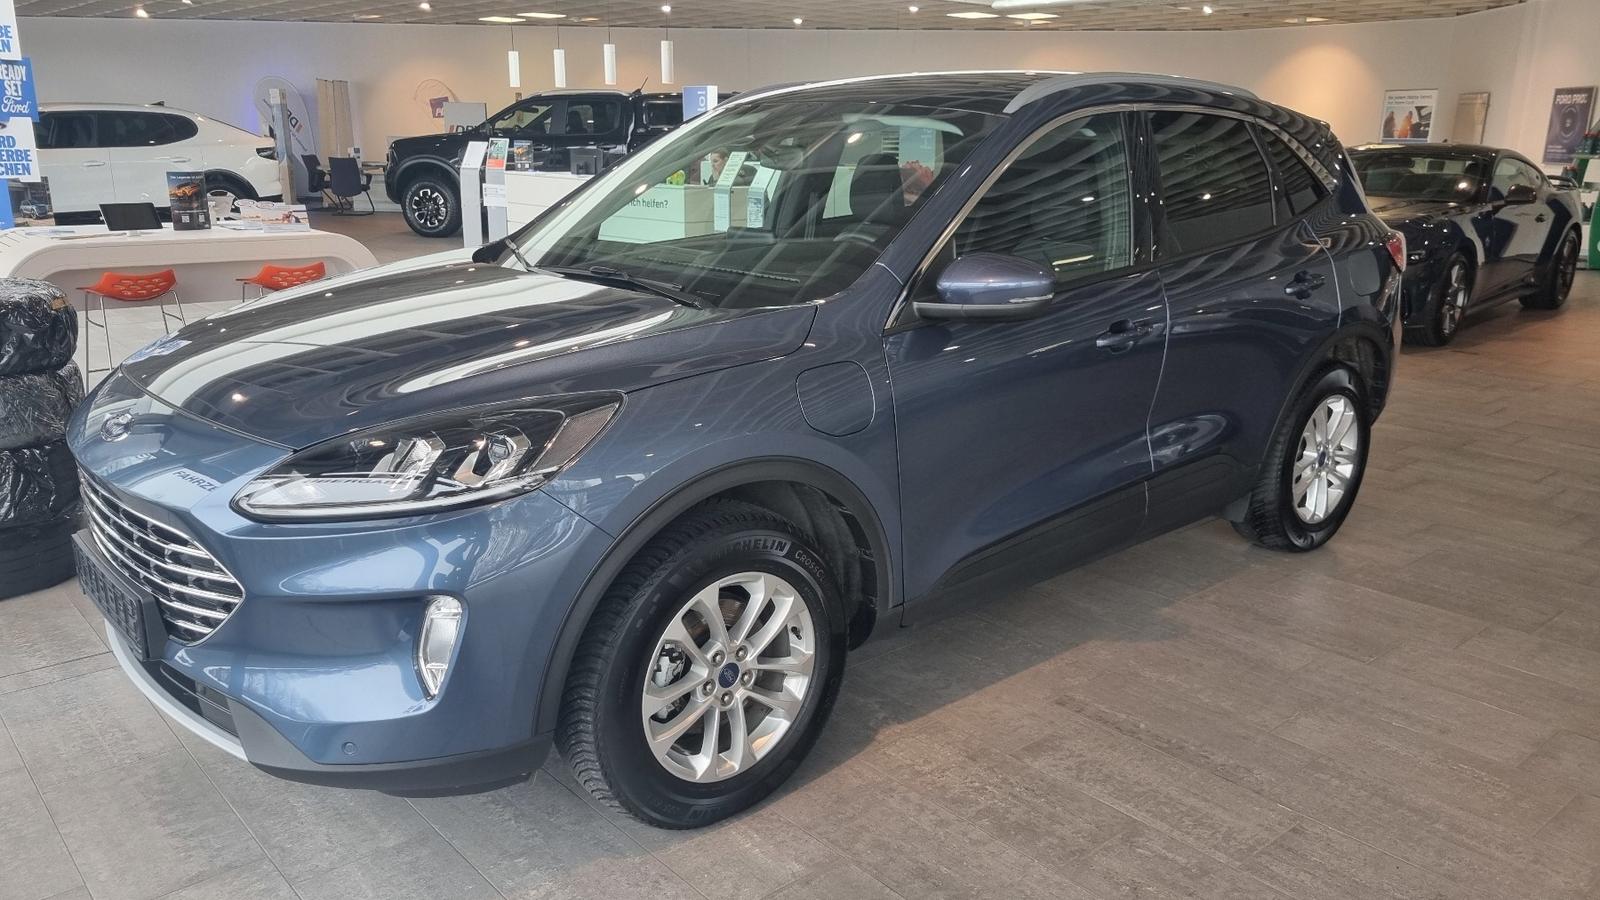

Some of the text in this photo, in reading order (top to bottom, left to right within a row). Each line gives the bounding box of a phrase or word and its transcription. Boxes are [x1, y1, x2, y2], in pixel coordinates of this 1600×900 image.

[4, 80, 22, 97] SET
[1, 95, 31, 113] Ford
[642, 199, 669, 209] helfen?
